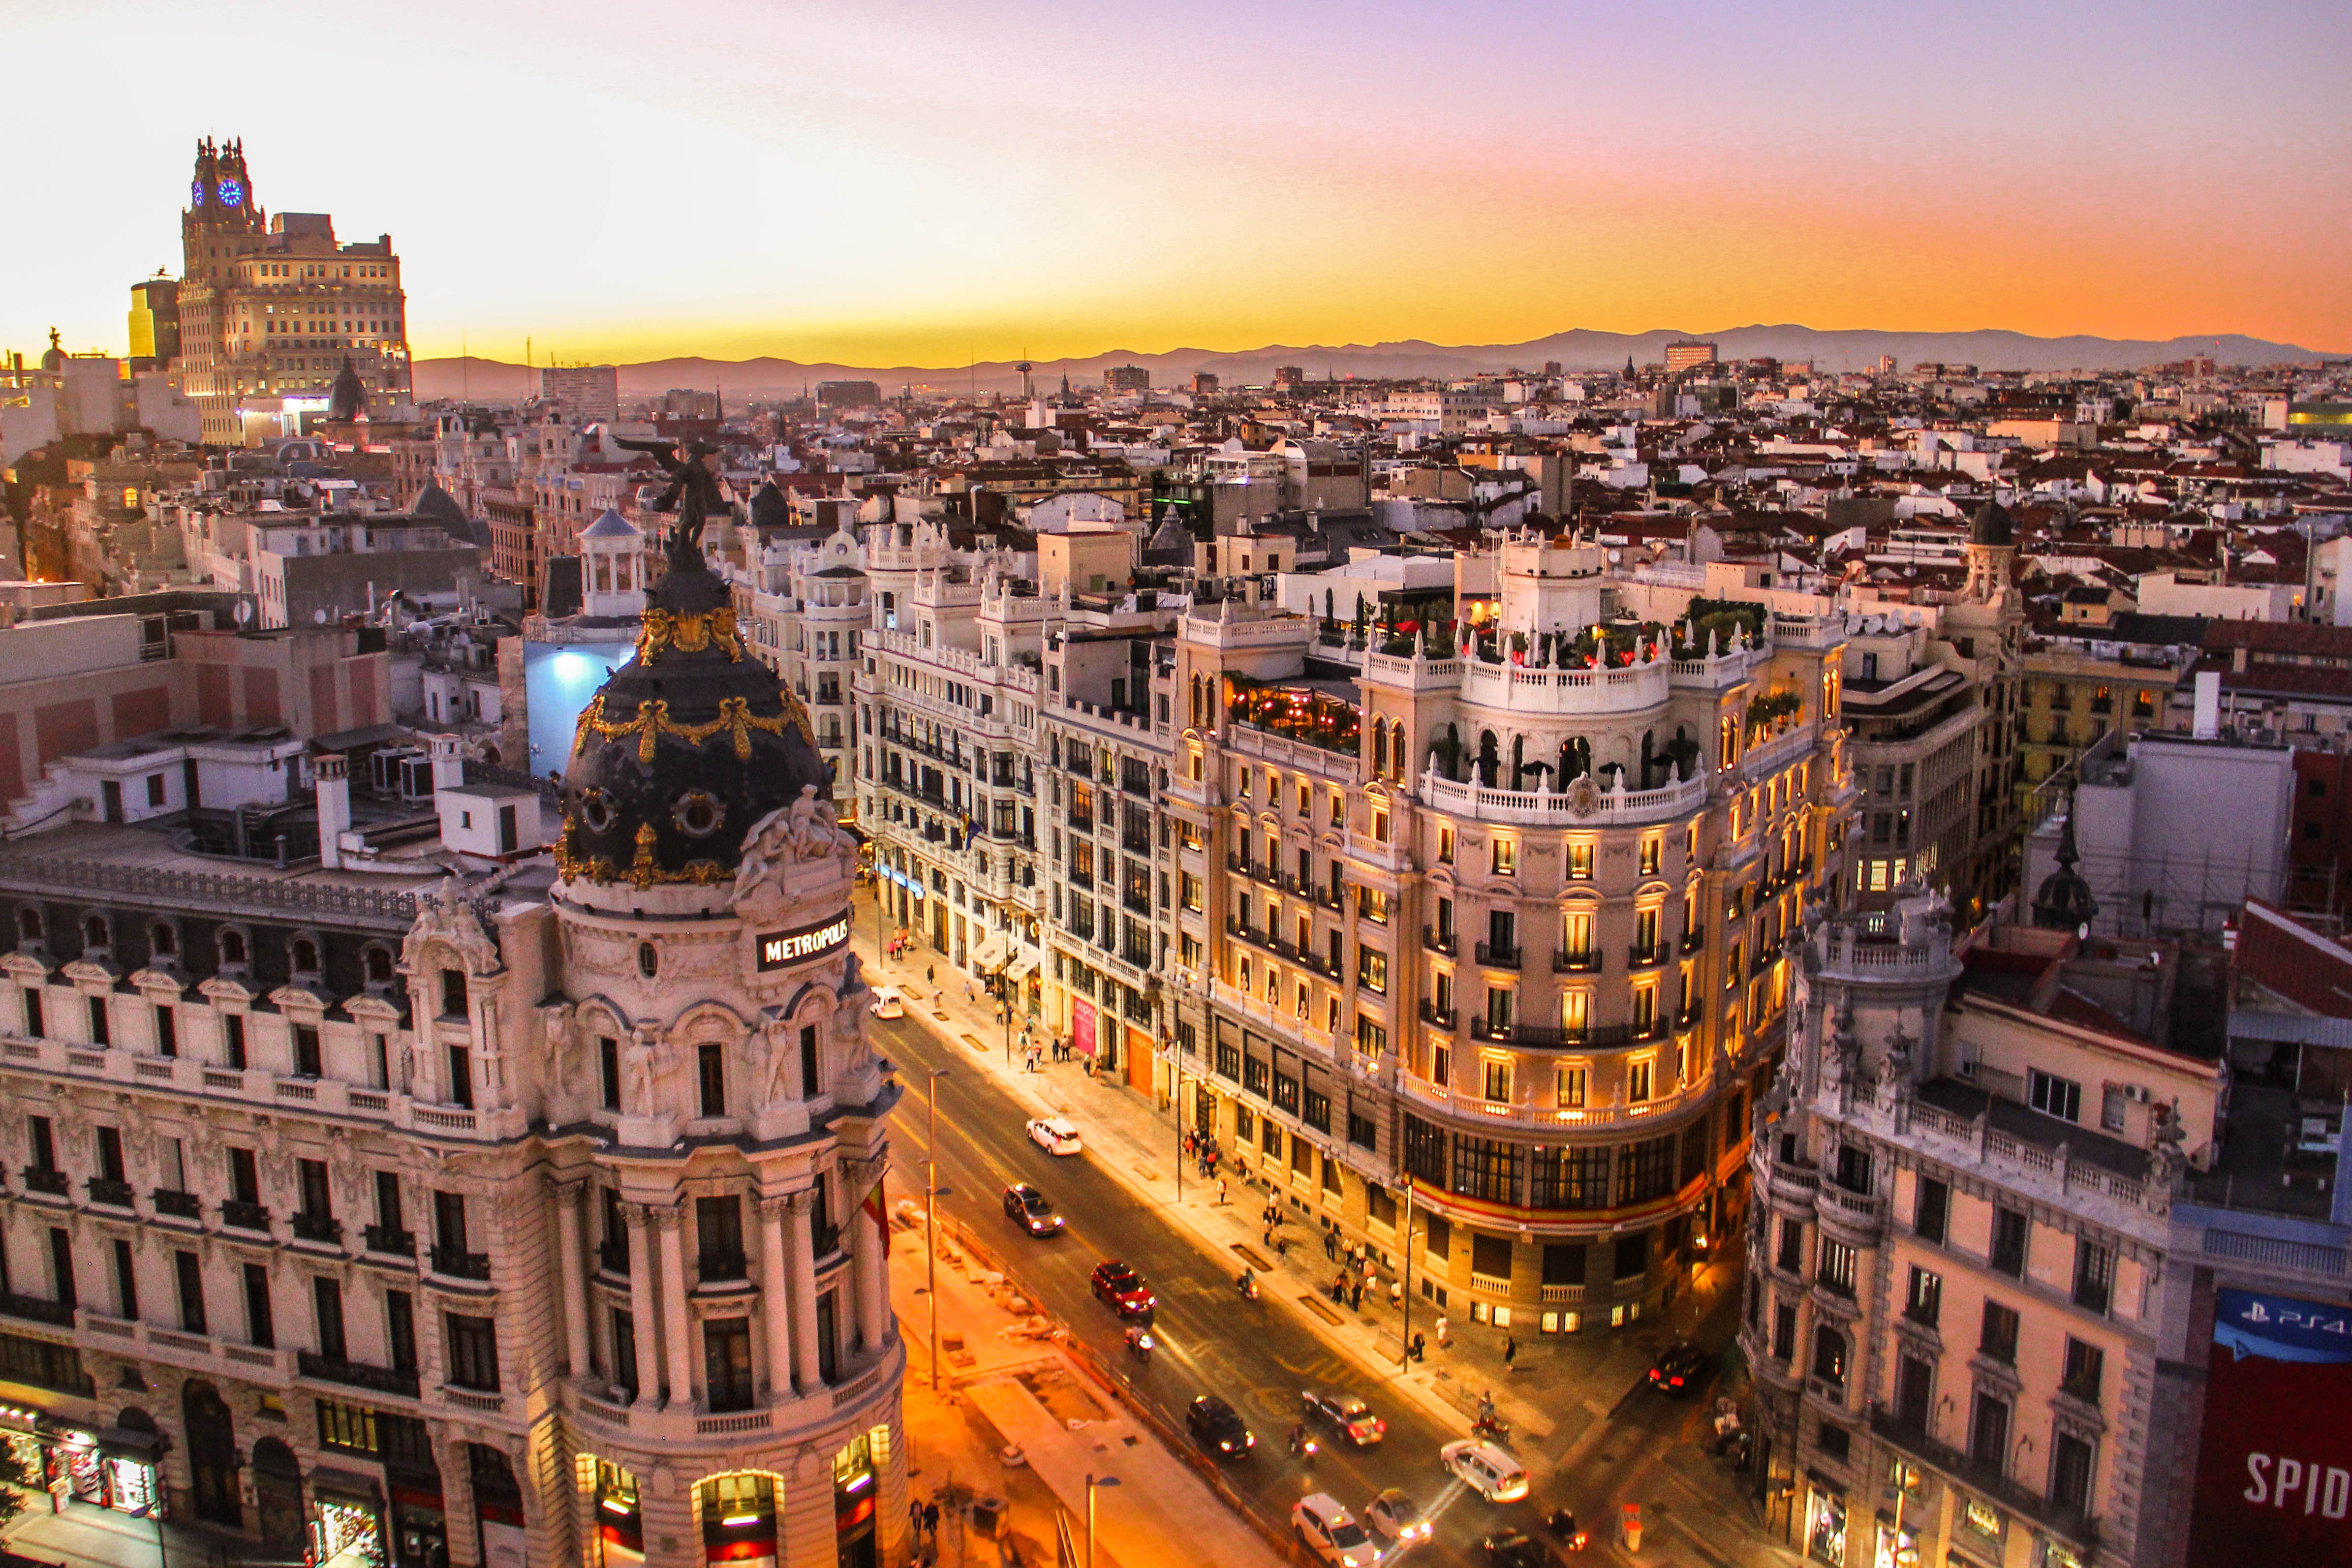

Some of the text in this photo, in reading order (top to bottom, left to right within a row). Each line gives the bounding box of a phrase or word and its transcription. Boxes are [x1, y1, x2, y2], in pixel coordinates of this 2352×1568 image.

[765, 919, 847, 962] METROPOLIS
[2279, 1310, 2345, 1334] PS4
[2243, 1452, 2351, 1519] SPID
